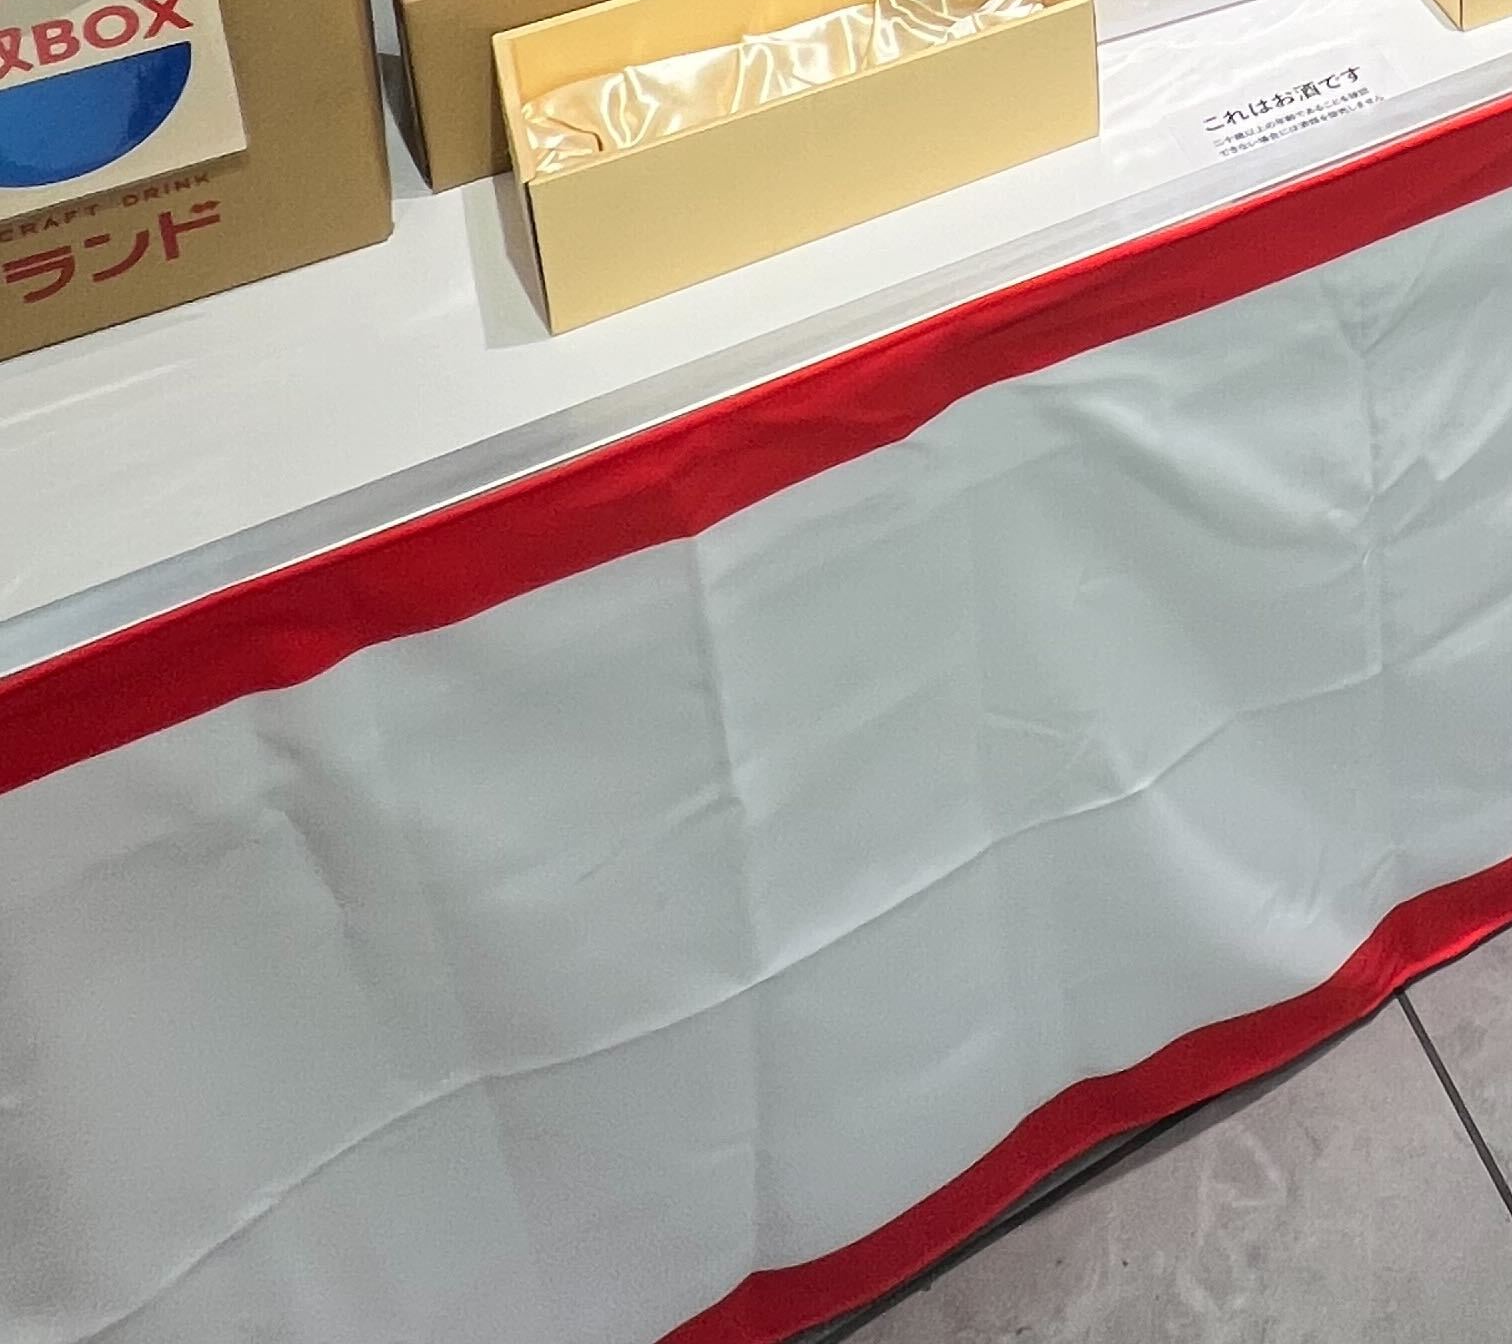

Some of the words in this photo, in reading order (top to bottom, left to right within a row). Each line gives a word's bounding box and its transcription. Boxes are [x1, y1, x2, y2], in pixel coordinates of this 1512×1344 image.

[1202, 65, 1361, 133] これはお酒です
[120, 171, 211, 208] DRINK
[2, 199, 222, 305] ランド
